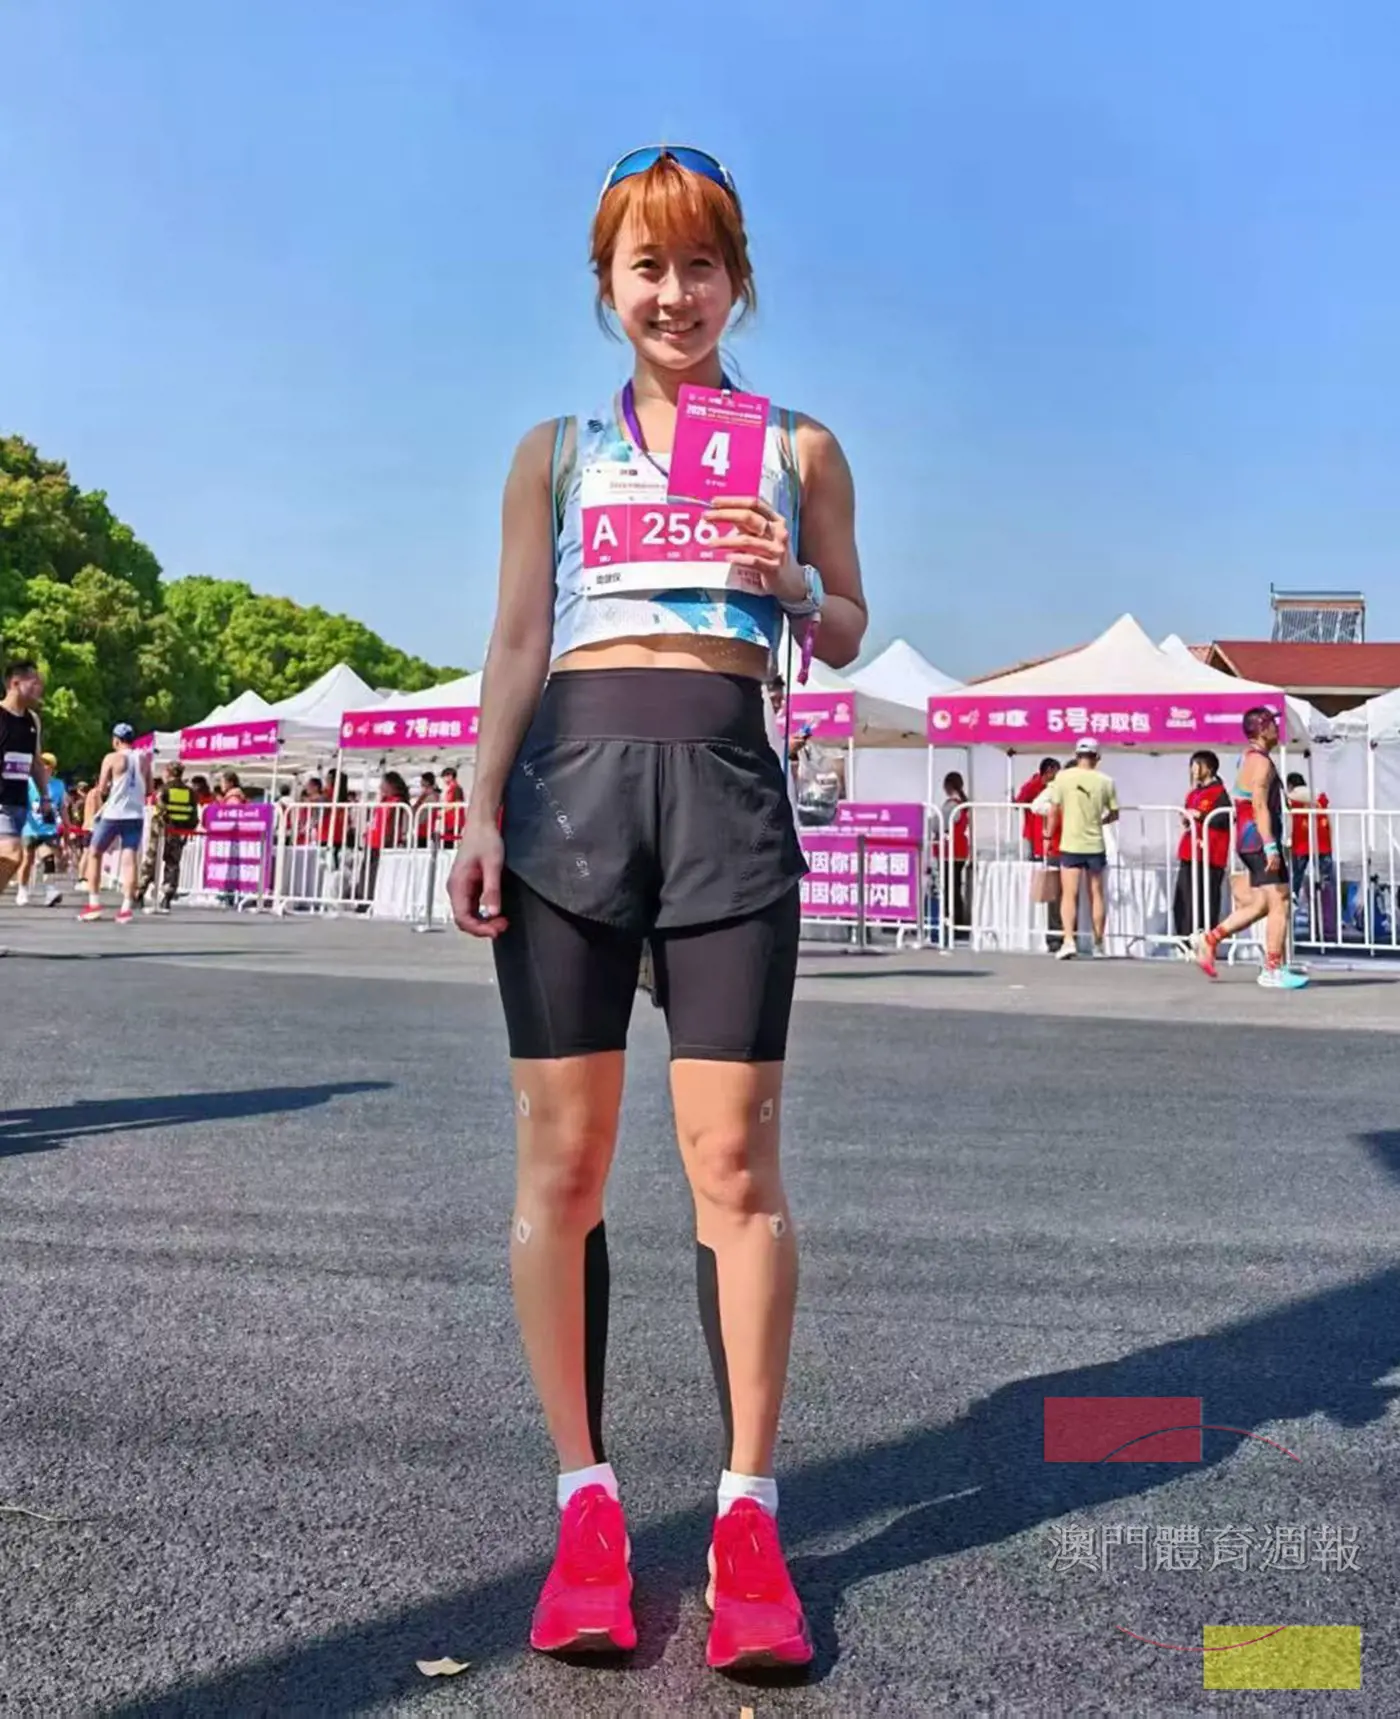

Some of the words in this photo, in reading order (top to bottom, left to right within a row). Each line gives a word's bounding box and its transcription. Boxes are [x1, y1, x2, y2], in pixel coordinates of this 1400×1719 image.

[701, 431, 731, 477] 4
[592, 513, 619, 551] A
[1047, 707, 1150, 734] 5号存取包
